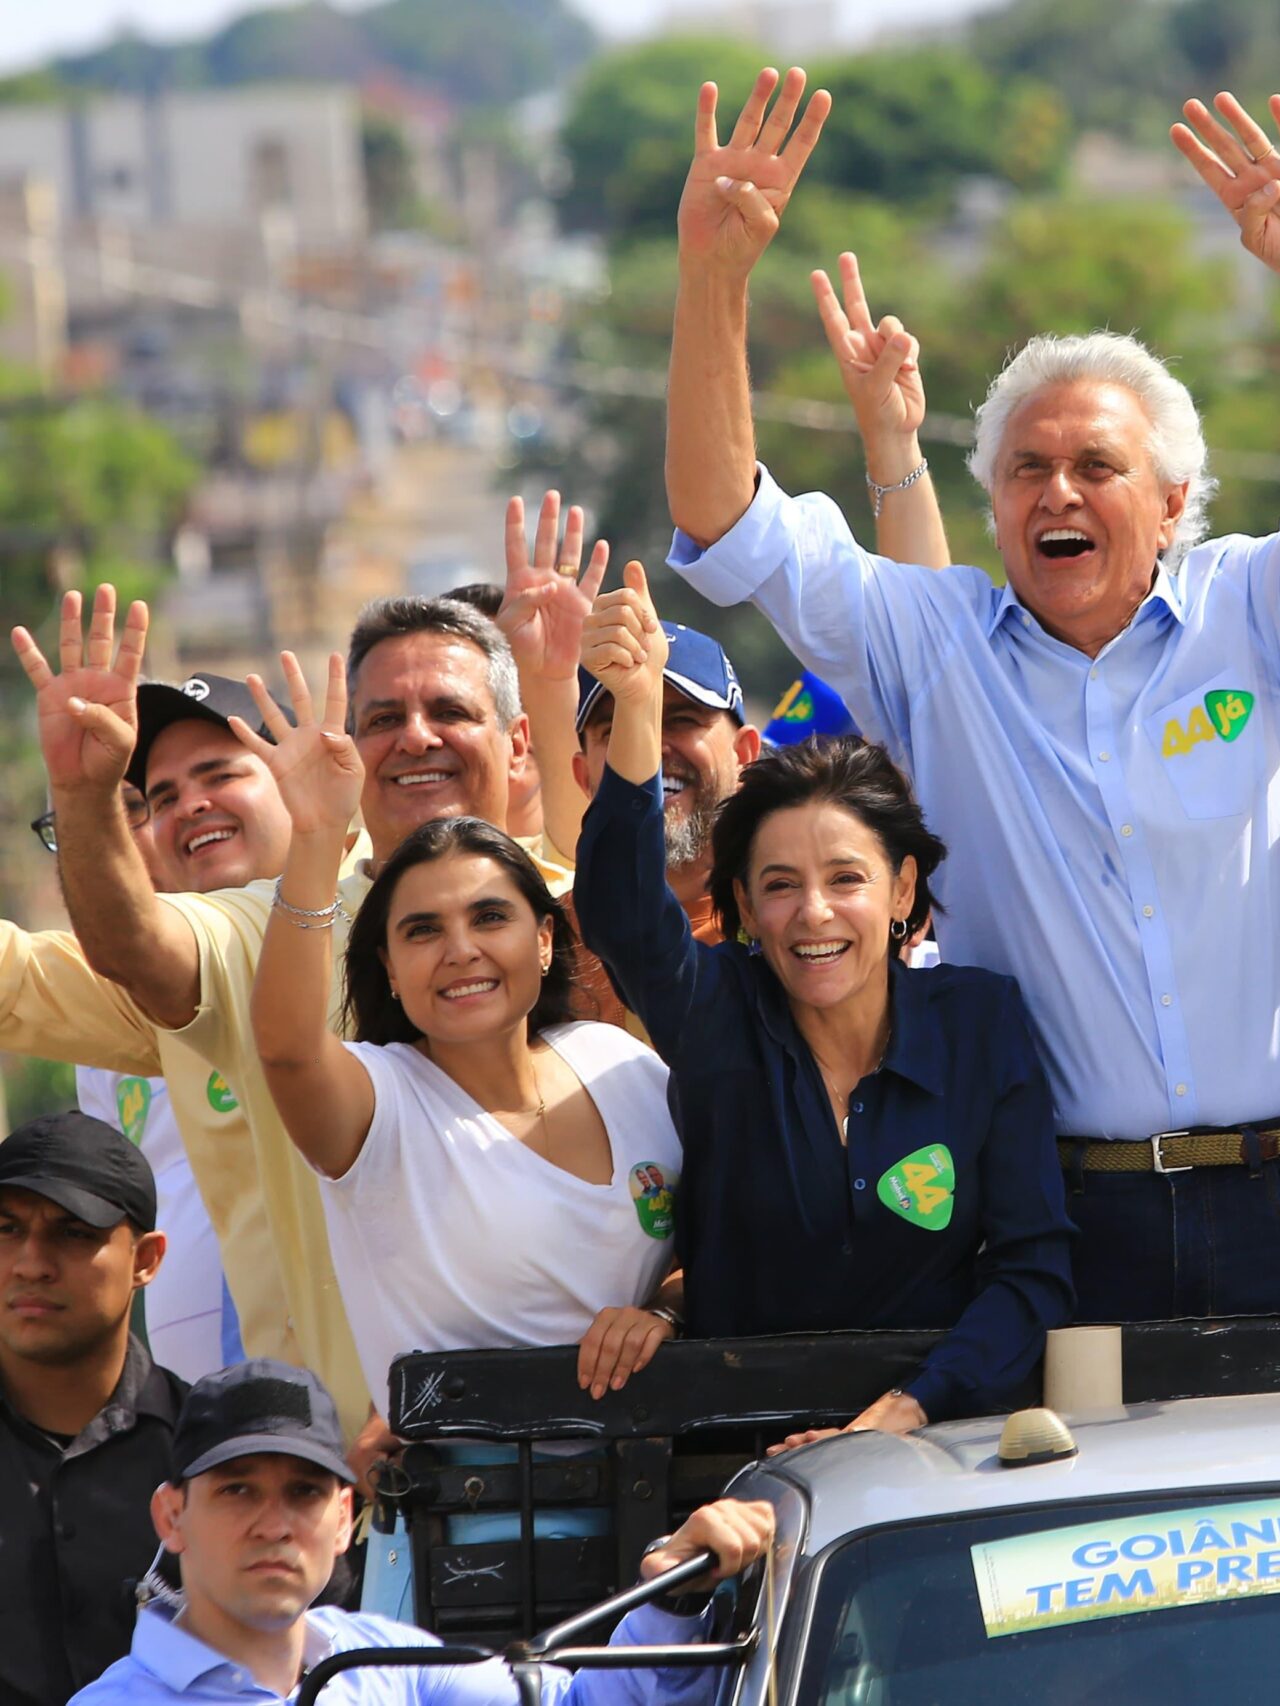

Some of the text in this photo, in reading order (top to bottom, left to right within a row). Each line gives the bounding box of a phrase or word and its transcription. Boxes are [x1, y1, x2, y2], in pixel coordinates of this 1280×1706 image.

[1161, 694, 1247, 759] 44 Já
[1026, 1570, 1156, 1614] TEM
